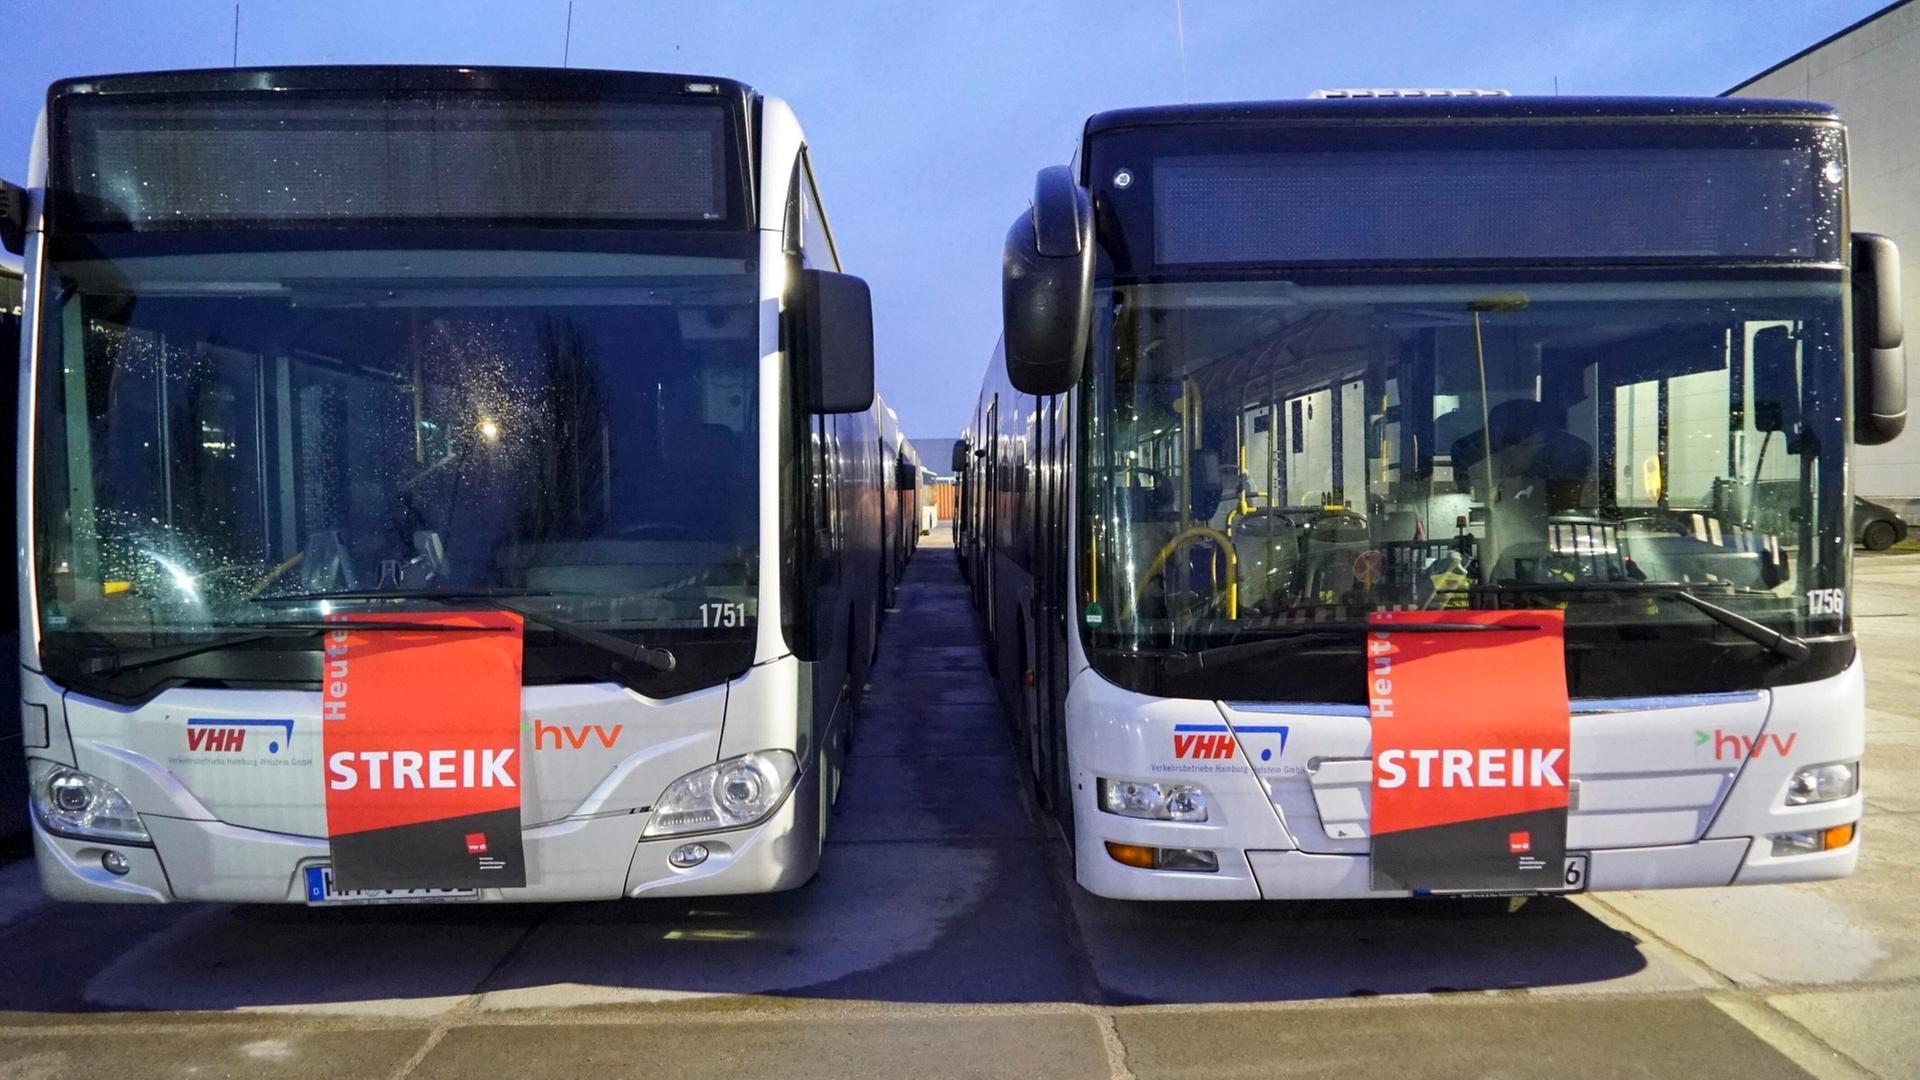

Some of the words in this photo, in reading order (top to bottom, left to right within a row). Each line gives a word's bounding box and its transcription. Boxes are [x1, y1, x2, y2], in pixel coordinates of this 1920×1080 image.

[699, 603, 745, 627] 1751
[1807, 588, 1843, 614] 1756
[187, 728, 246, 752] VHH
[534, 719, 623, 750] hvv
[1174, 735, 1237, 759] VHH
[1714, 729, 1798, 760] hvv
[329, 748, 517, 790] STREIK
[1378, 748, 1565, 789] STREIK
